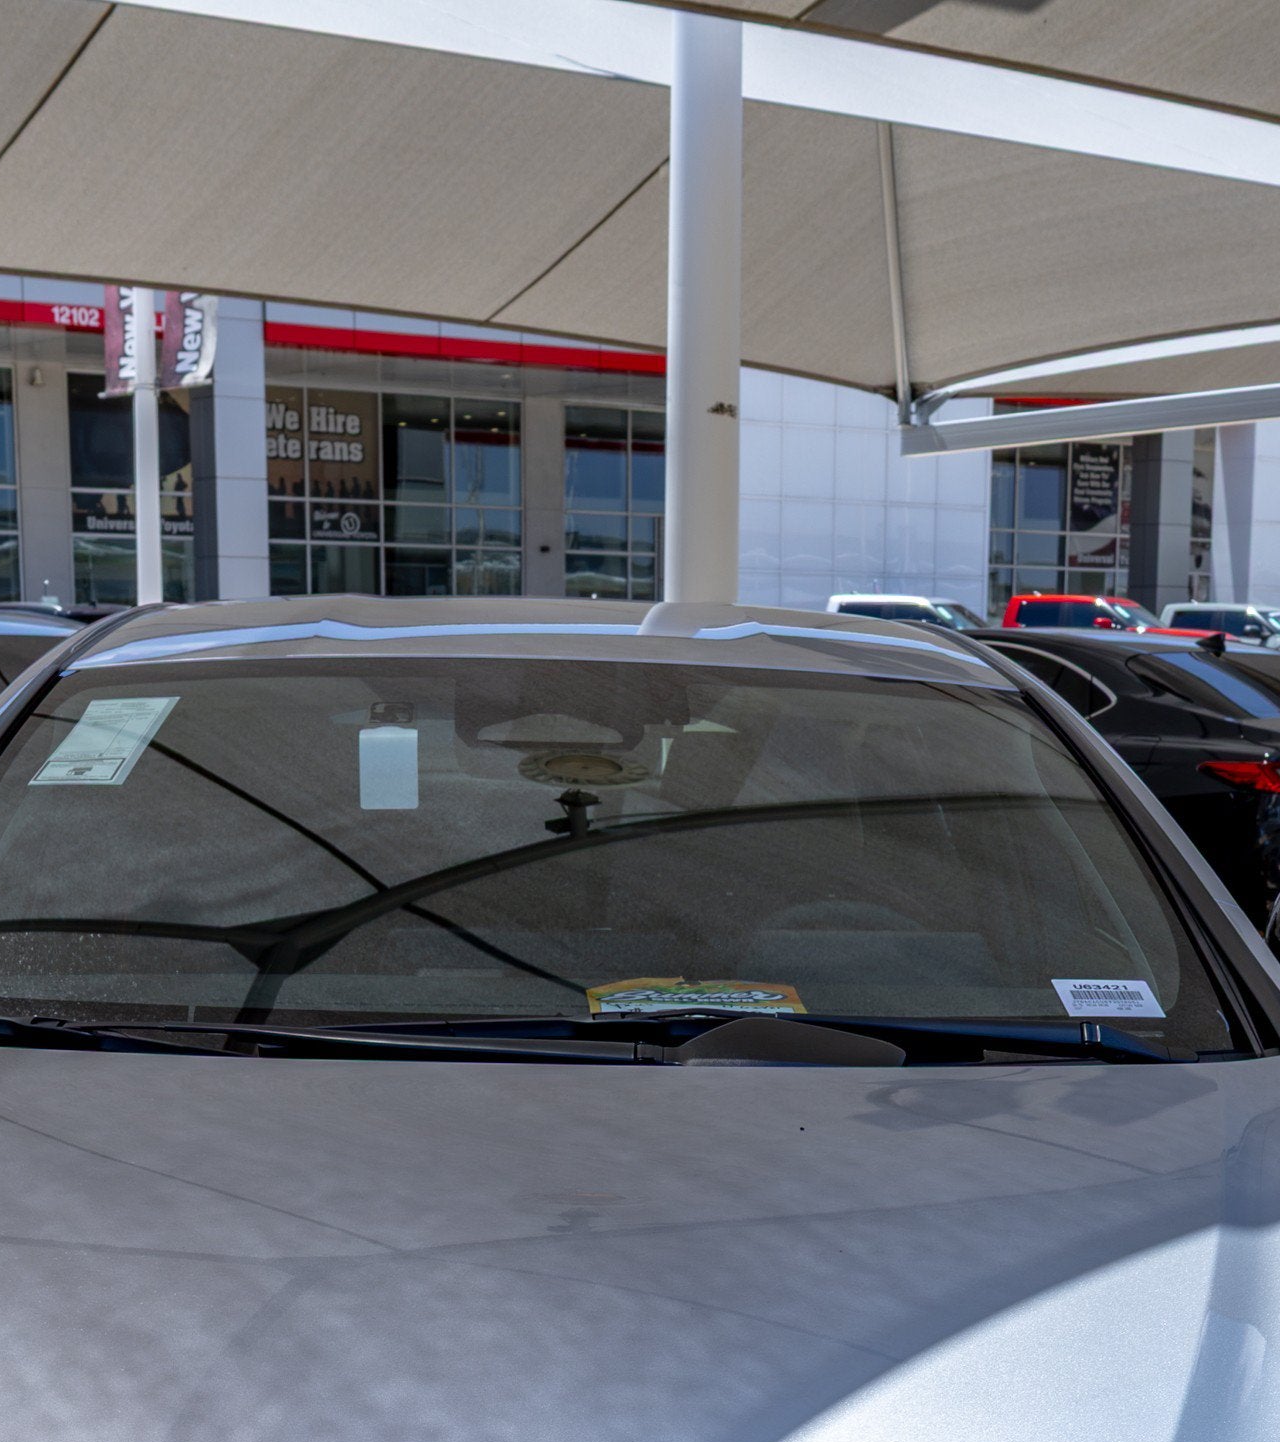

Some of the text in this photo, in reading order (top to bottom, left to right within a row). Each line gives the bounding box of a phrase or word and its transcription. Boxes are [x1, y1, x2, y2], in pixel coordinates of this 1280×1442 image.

[52, 306, 100, 327] 12102
[175, 308, 203, 373] New
[266, 402, 300, 431] We
[309, 406, 361, 434] Hire
[266, 433, 363, 462] eterans
